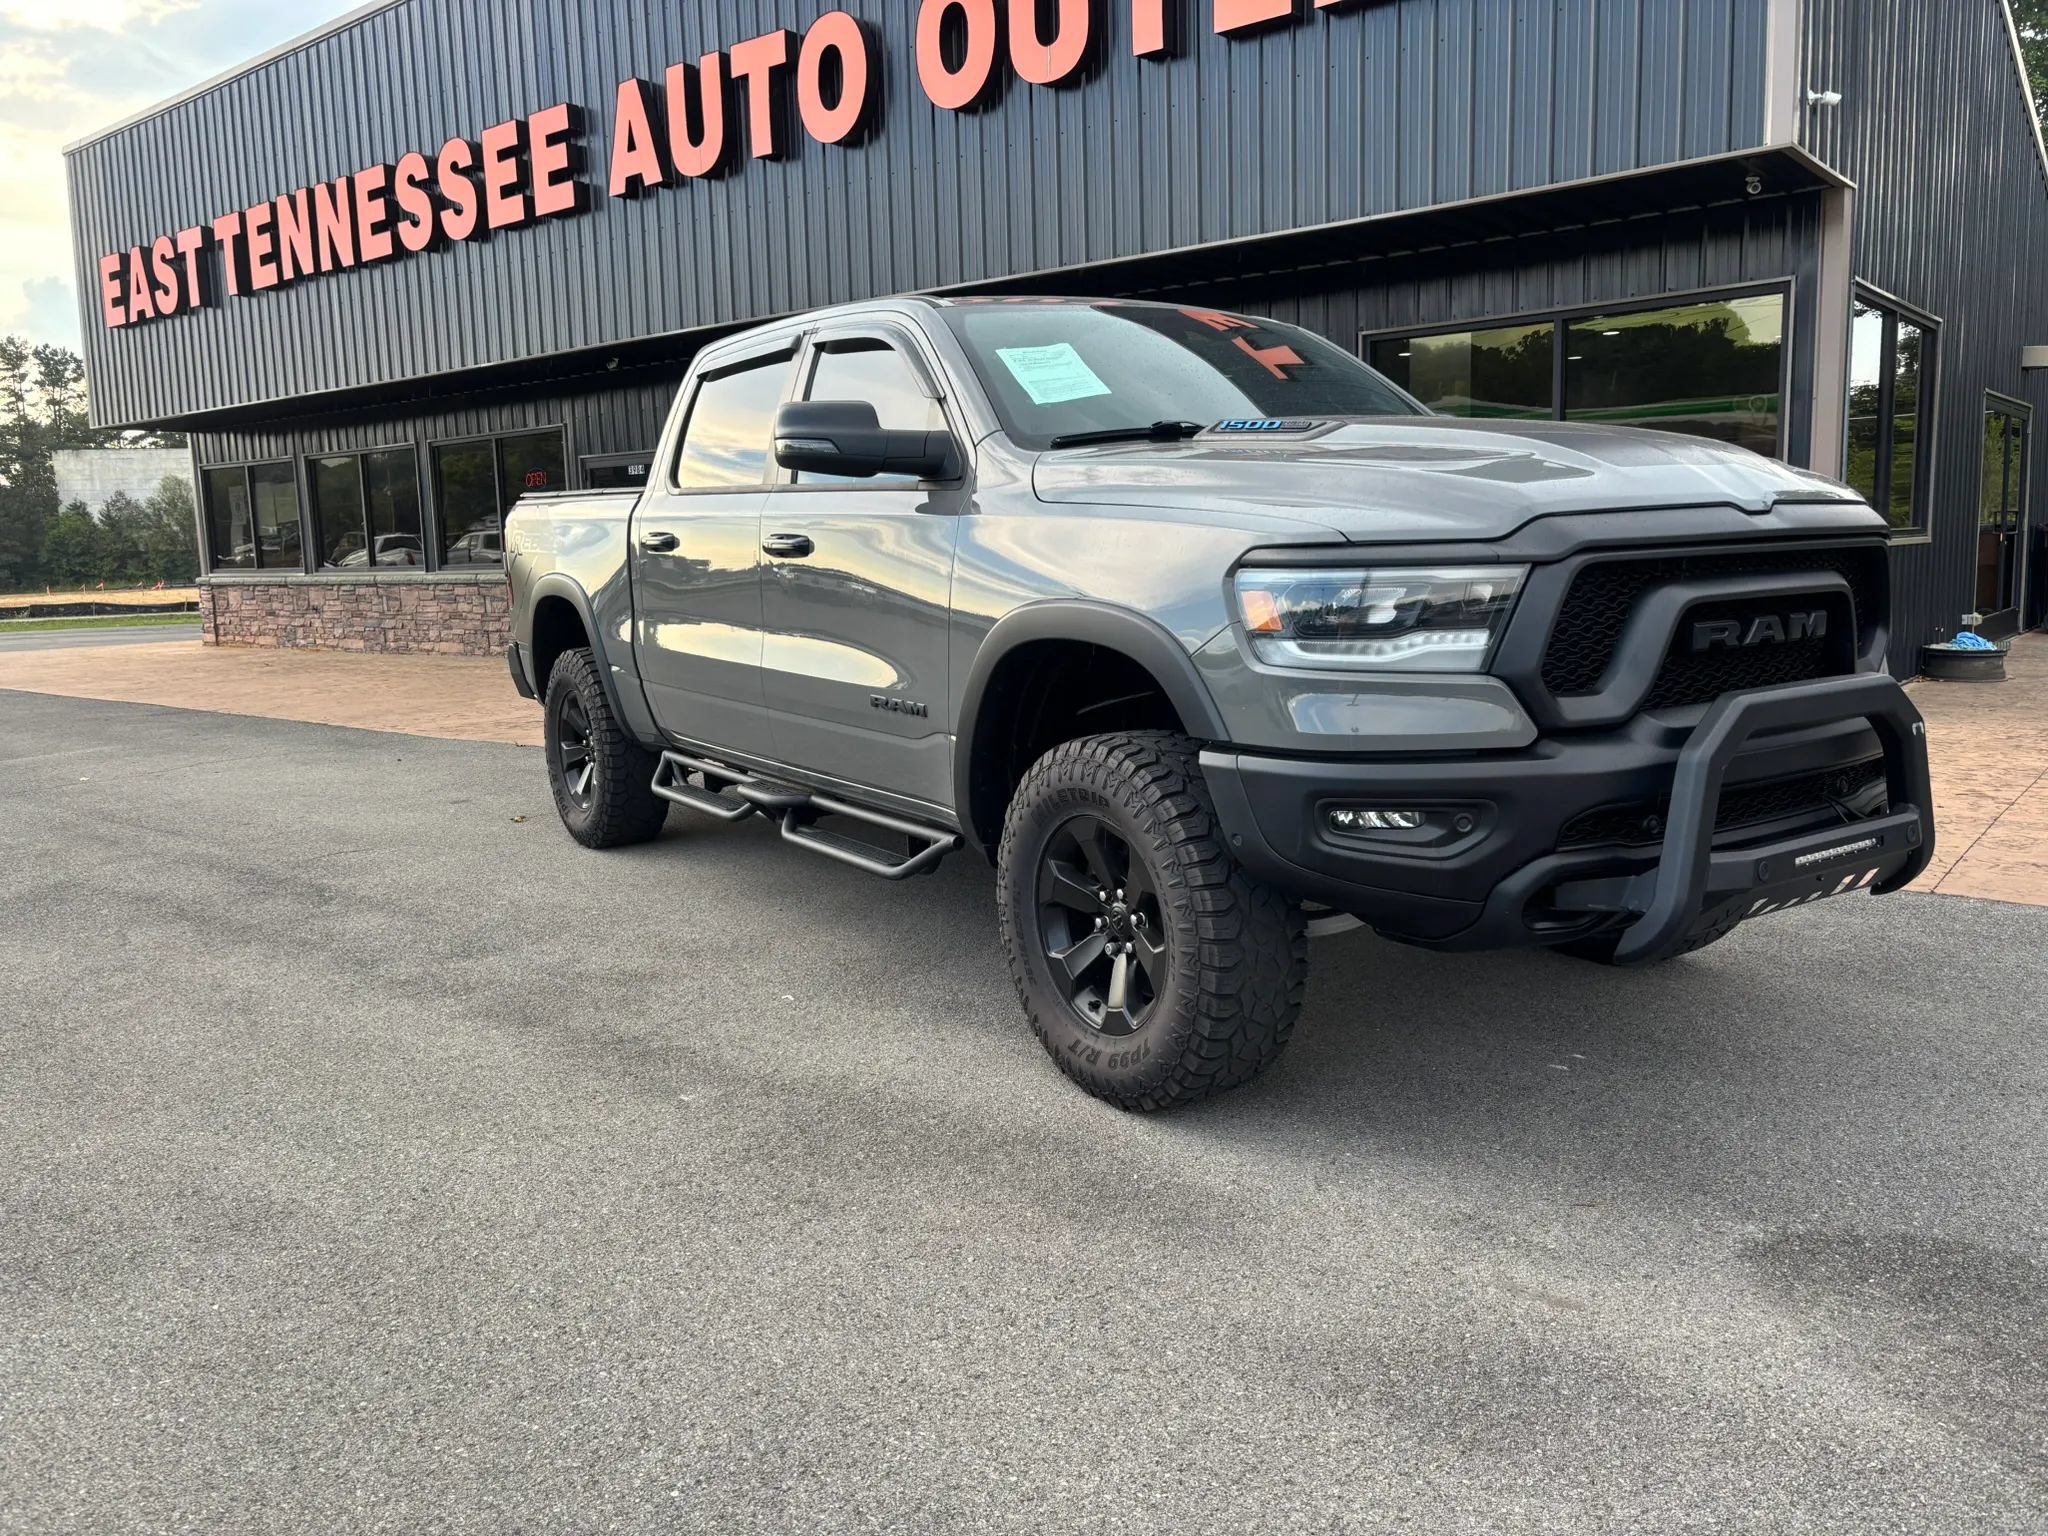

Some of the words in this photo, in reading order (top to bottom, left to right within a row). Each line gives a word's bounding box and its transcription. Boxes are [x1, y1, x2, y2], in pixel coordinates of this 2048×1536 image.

[100, 226, 203, 329] EAST
[213, 102, 577, 296] TENNESSEE
[609, 9, 868, 198] AUTO
[1219, 420, 1282, 430] 1500
[525, 471, 547, 487] OPEN
[1692, 609, 1828, 651] RAM
[869, 694, 929, 718] RAM
